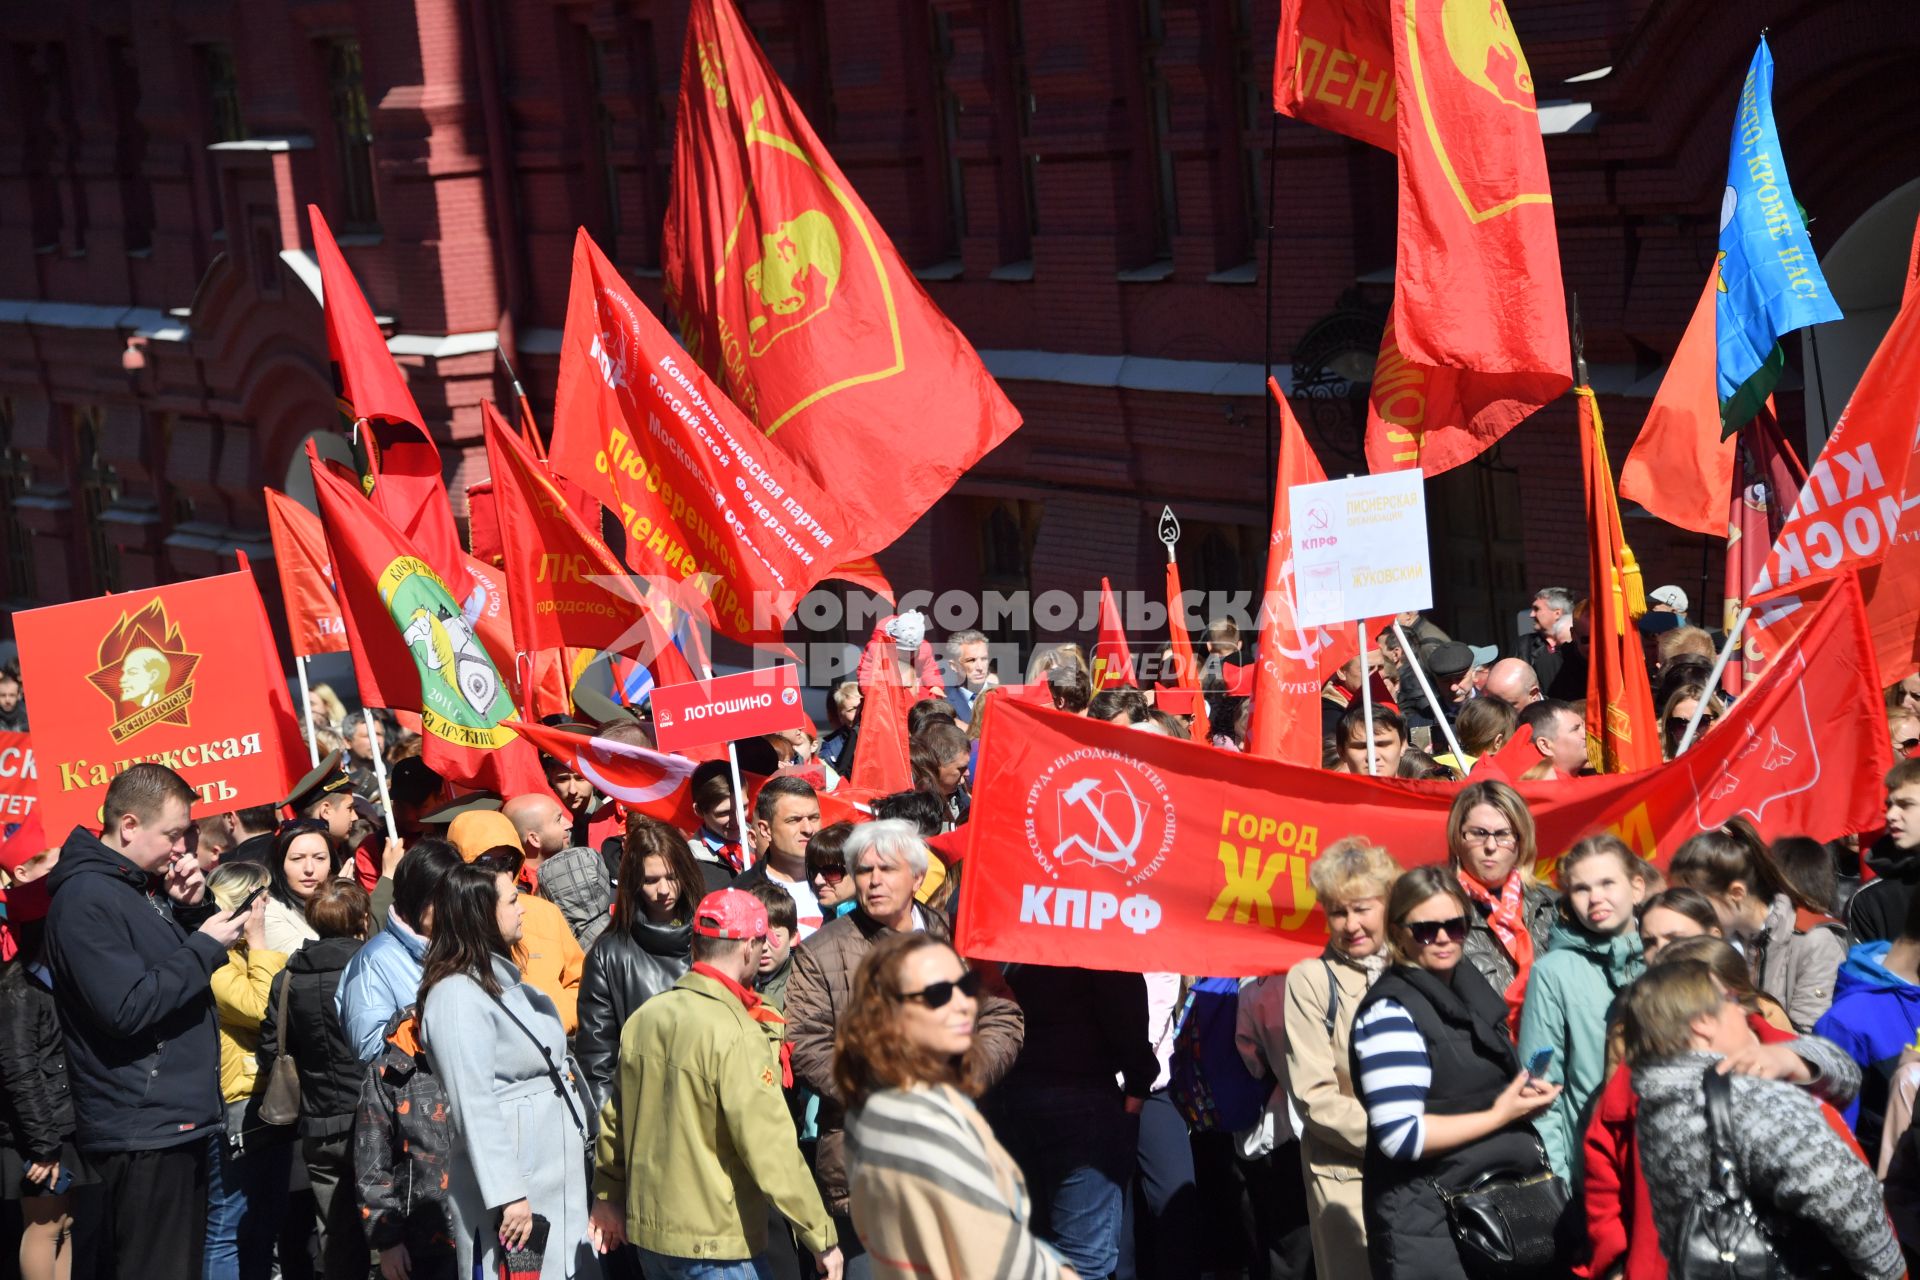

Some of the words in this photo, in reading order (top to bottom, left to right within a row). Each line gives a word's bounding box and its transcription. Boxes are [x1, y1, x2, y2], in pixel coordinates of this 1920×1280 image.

[1747, 152, 1792, 240] КРОМЕ
[1778, 245, 1818, 299] НАС!
[650, 373, 730, 468] Российской
[735, 476, 814, 566] Федерации
[659, 356, 784, 499] Коммунистическая
[782, 496, 833, 549] партия
[1346, 492, 1417, 514] ПИОНЕРСКАЯ
[1301, 535, 1337, 550] КПРФ
[1353, 561, 1423, 588] ЖУКОВСКИЙ
[118, 706, 158, 737] ВСЕГДА
[683, 693, 772, 722] ЛОТОШИНО
[1027, 773, 1052, 806] ТРУД
[1054, 747, 1167, 795] НАРОДОВЛАСТИЕ
[1024, 818, 1053, 874] РОССИЯ
[1133, 803, 1176, 884] СОЦИАЛИЗМ
[1221, 809, 1318, 857] ГОРОД
[1019, 884, 1162, 934] КПРФ
